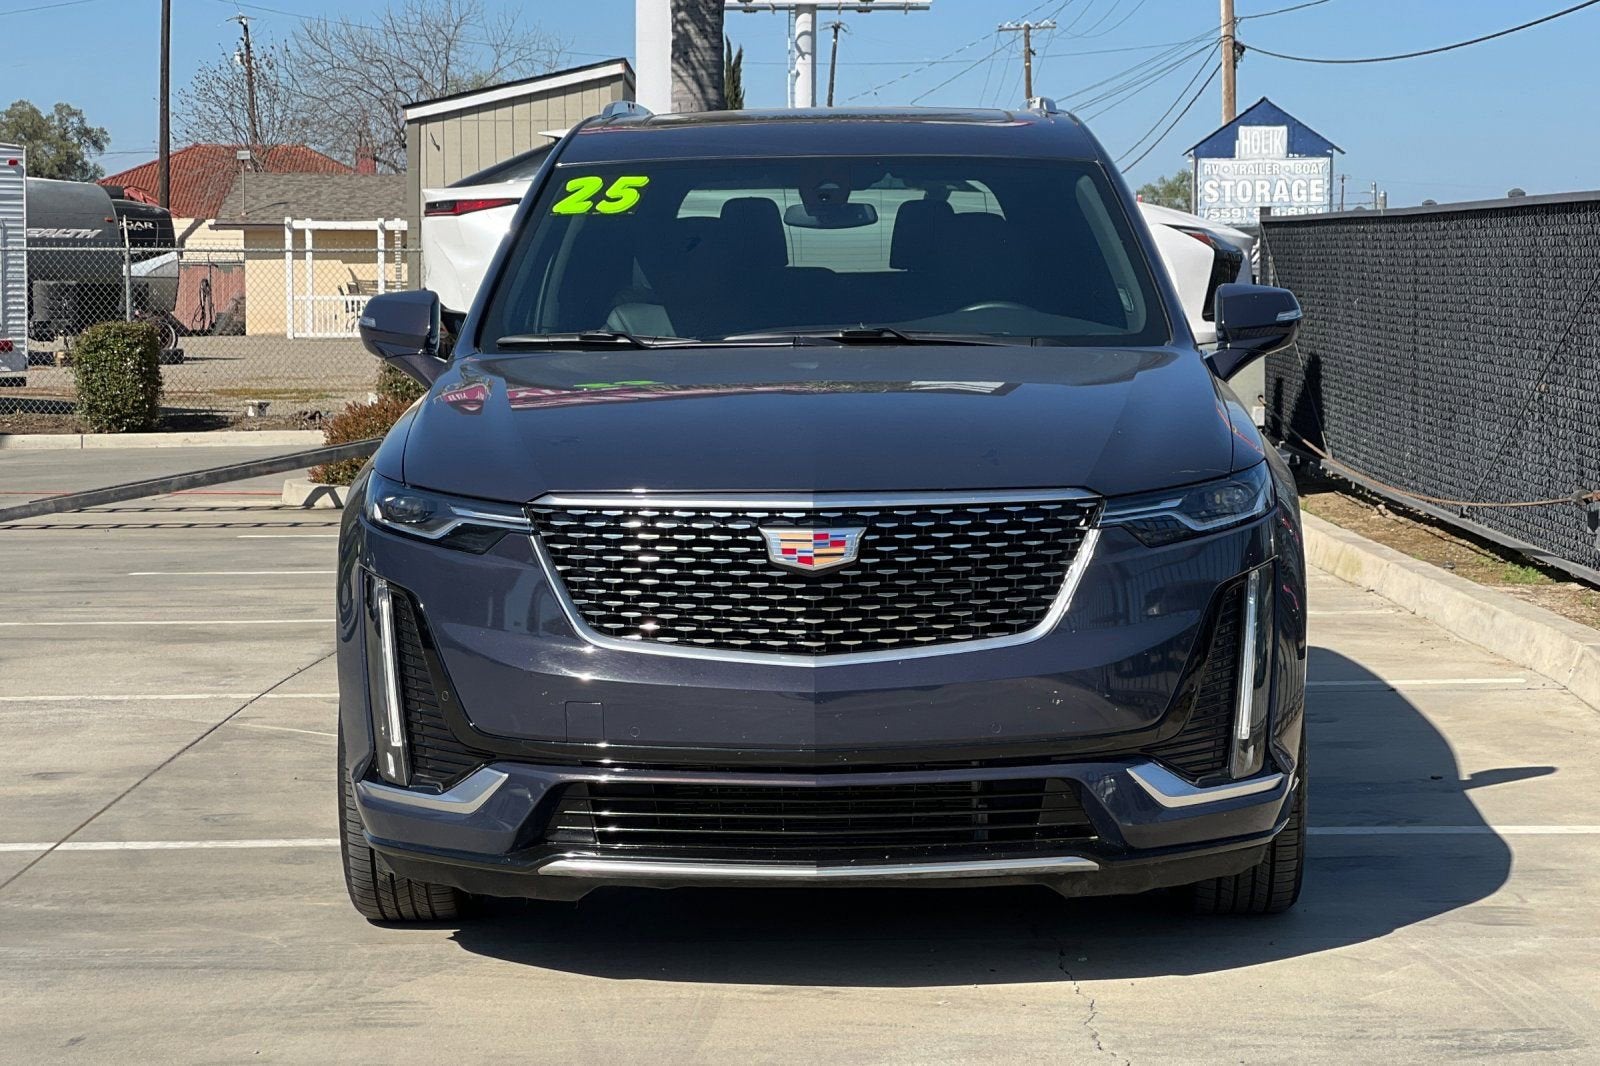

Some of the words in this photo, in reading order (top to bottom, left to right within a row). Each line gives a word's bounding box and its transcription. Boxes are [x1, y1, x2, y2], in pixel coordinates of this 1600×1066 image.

[1203, 163, 1220, 176] RV
[1232, 163, 1281, 176] TRAILER
[1294, 163, 1325, 176] BOAT
[552, 176, 650, 214] 25
[1203, 178, 1325, 204] STORAGE
[1204, 207, 1248, 220] (559)
